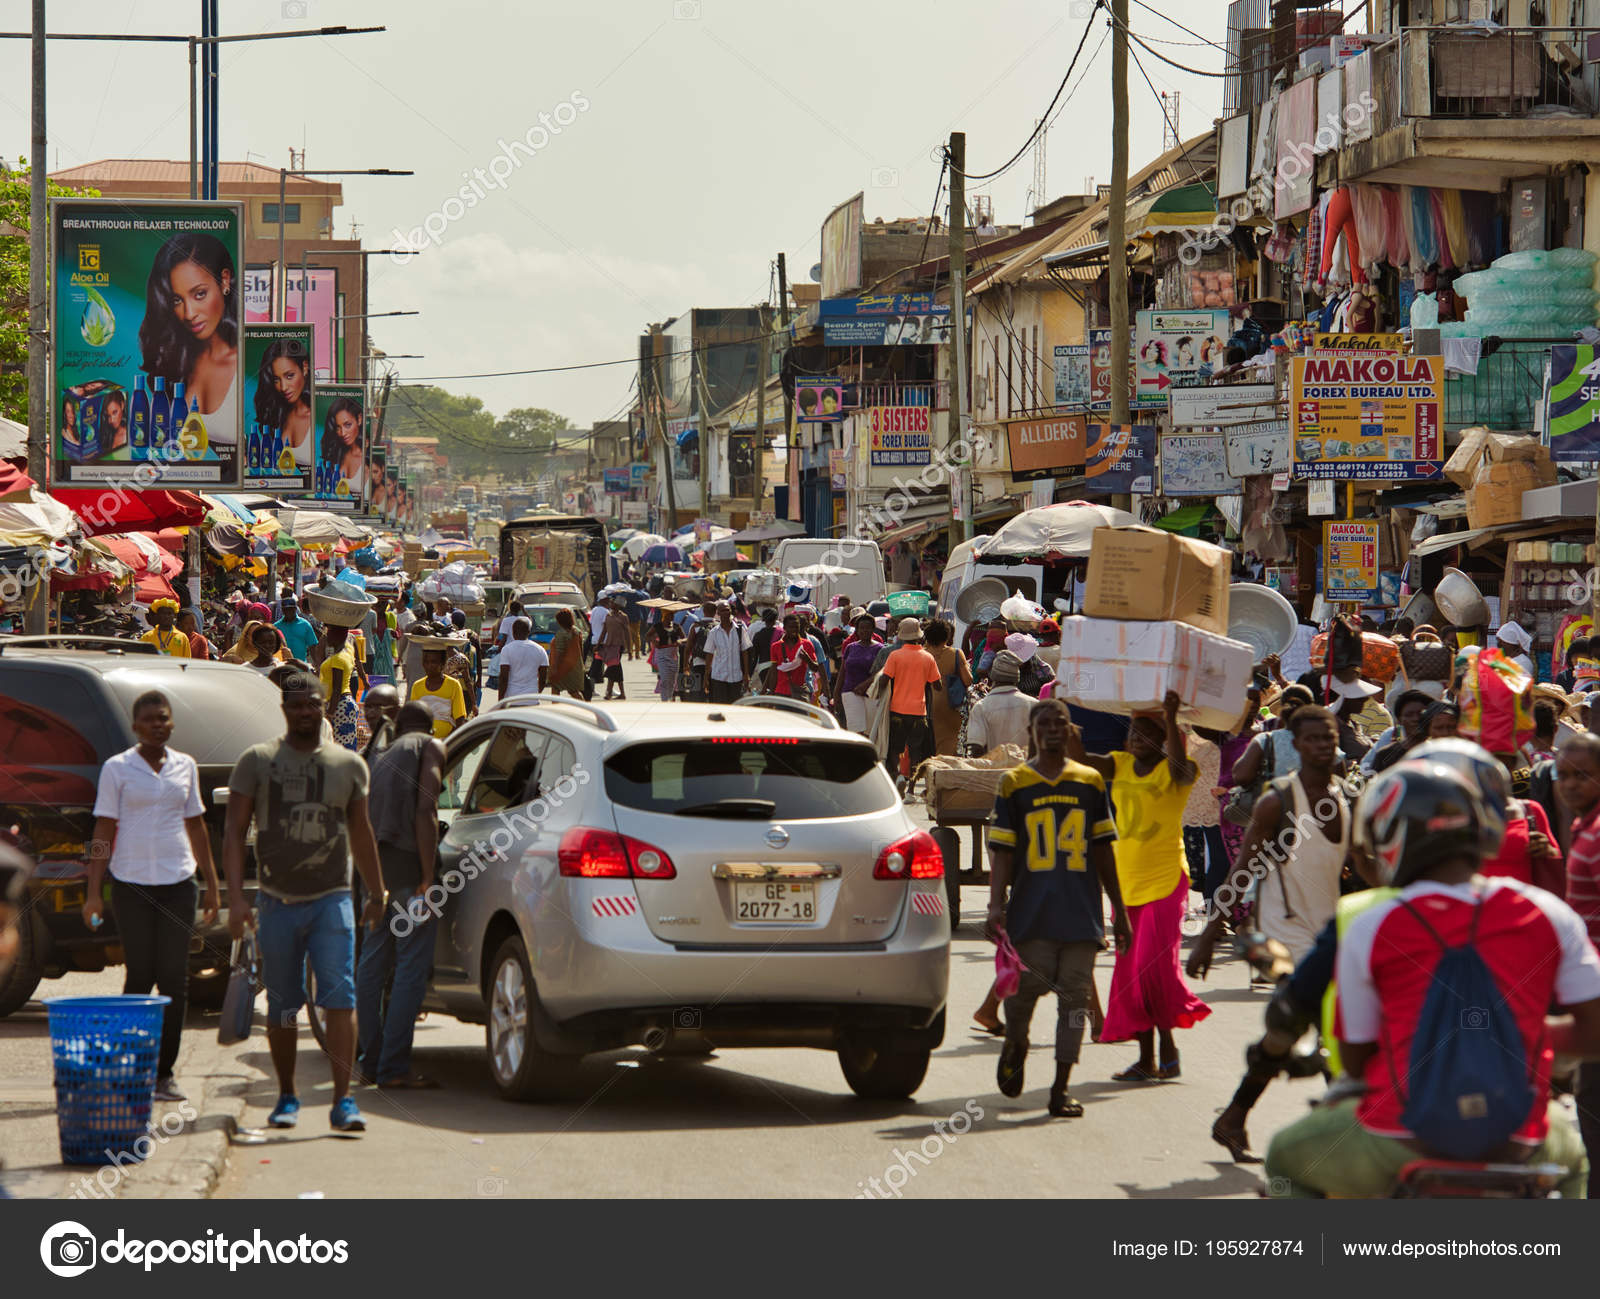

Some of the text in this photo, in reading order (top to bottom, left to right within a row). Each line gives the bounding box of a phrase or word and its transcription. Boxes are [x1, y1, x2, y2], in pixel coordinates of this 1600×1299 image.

[63, 219, 230, 230] BREAKTHROUGH RELAXER TECHNOLOGY
[70, 272, 110, 282] Aloe Oil
[824, 322, 886, 330] Beauty Xperts
[1304, 358, 1434, 384] MAKOLA
[1304, 386, 1435, 398] FOREX BUREAU LTD.
[1580, 386, 1600, 400] SE
[872, 408, 928, 432] 3 SISTERS
[1020, 422, 1078, 444] ALLDERS
[1102, 432, 1129, 446] 4G
[882, 434, 929, 448] FOREX BUREAU
[1097, 449, 1144, 458] AVAILABLE
[1109, 462, 1132, 471] HERE
[1332, 525, 1364, 534] MAKOLA
[1025, 808, 1087, 872] 04
